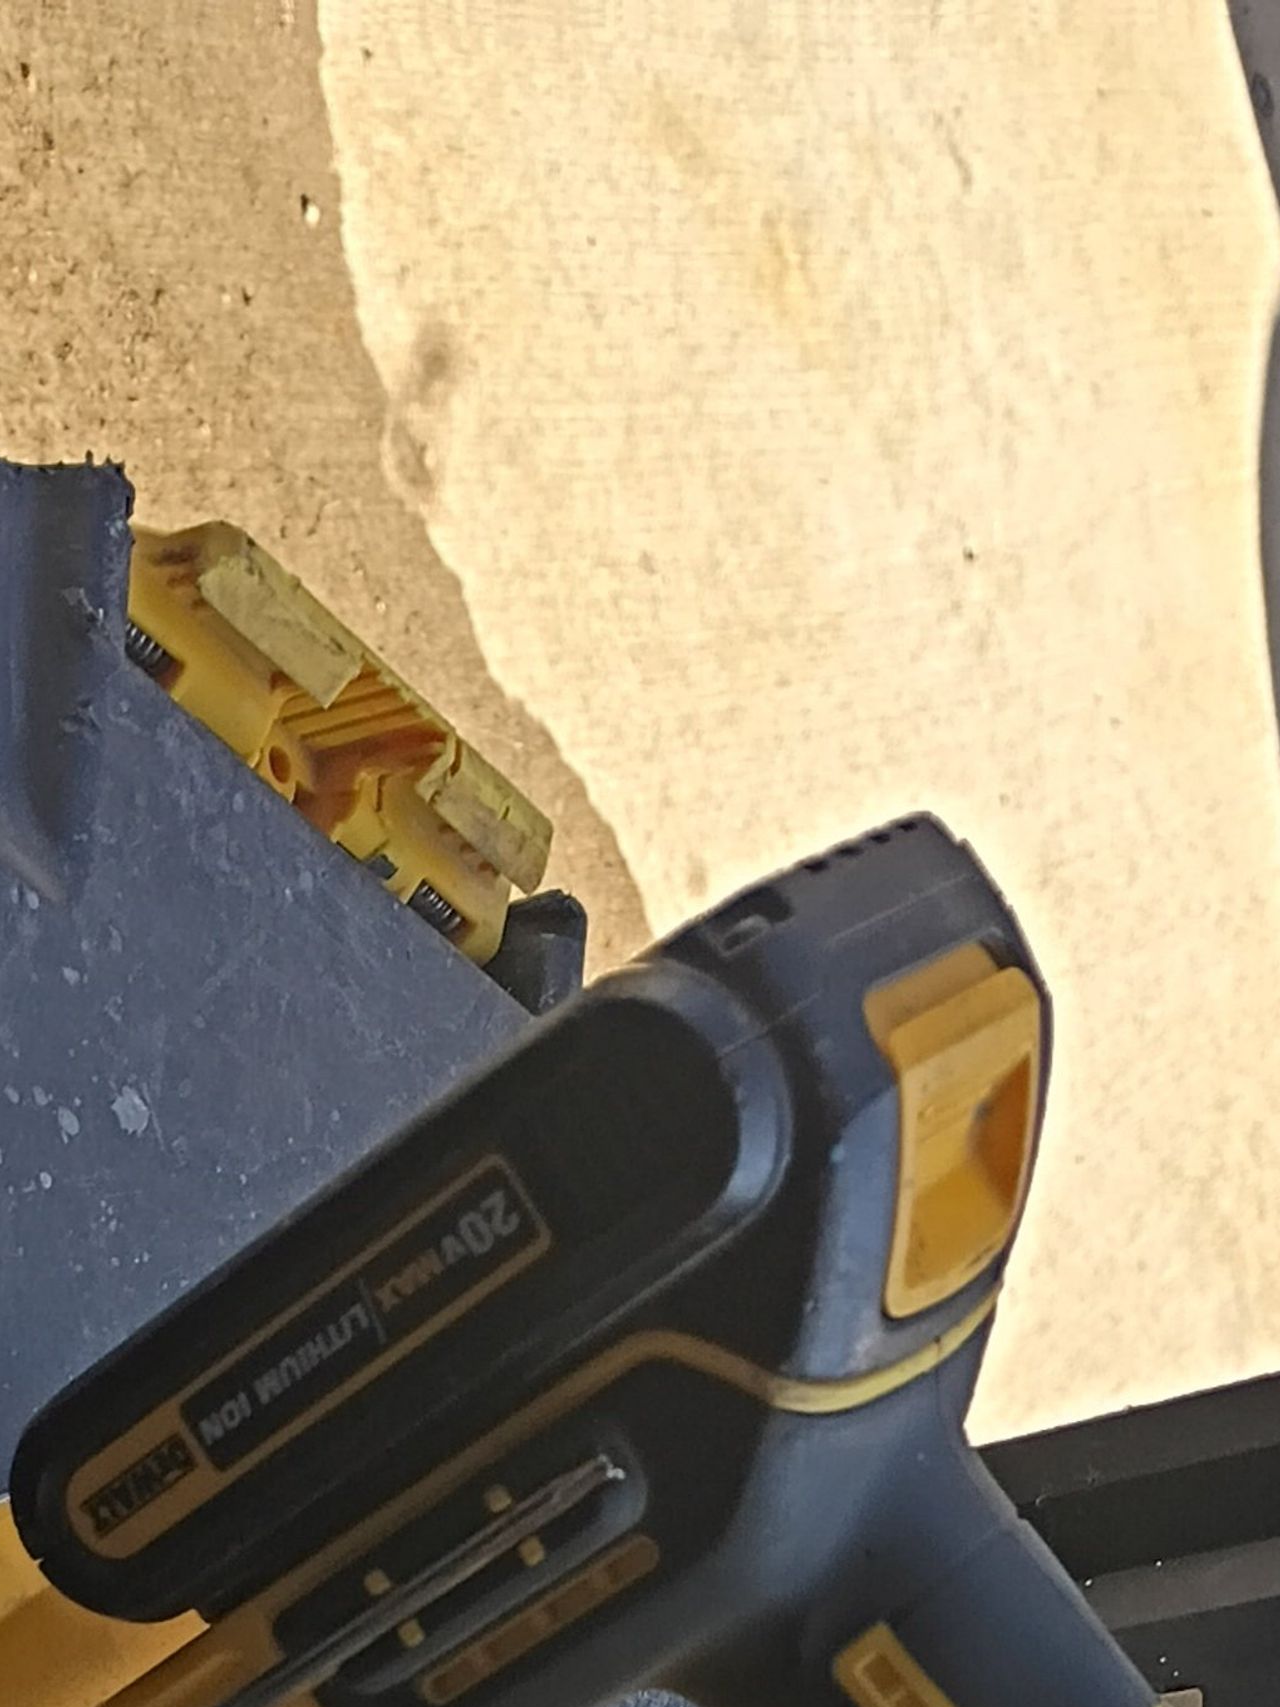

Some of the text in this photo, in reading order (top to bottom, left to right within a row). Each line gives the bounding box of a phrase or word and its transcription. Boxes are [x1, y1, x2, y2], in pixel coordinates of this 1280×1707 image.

[375, 1246, 445, 1312] MAX
[253, 1302, 371, 1404] LITHIUM
[200, 1391, 258, 1447] ION
